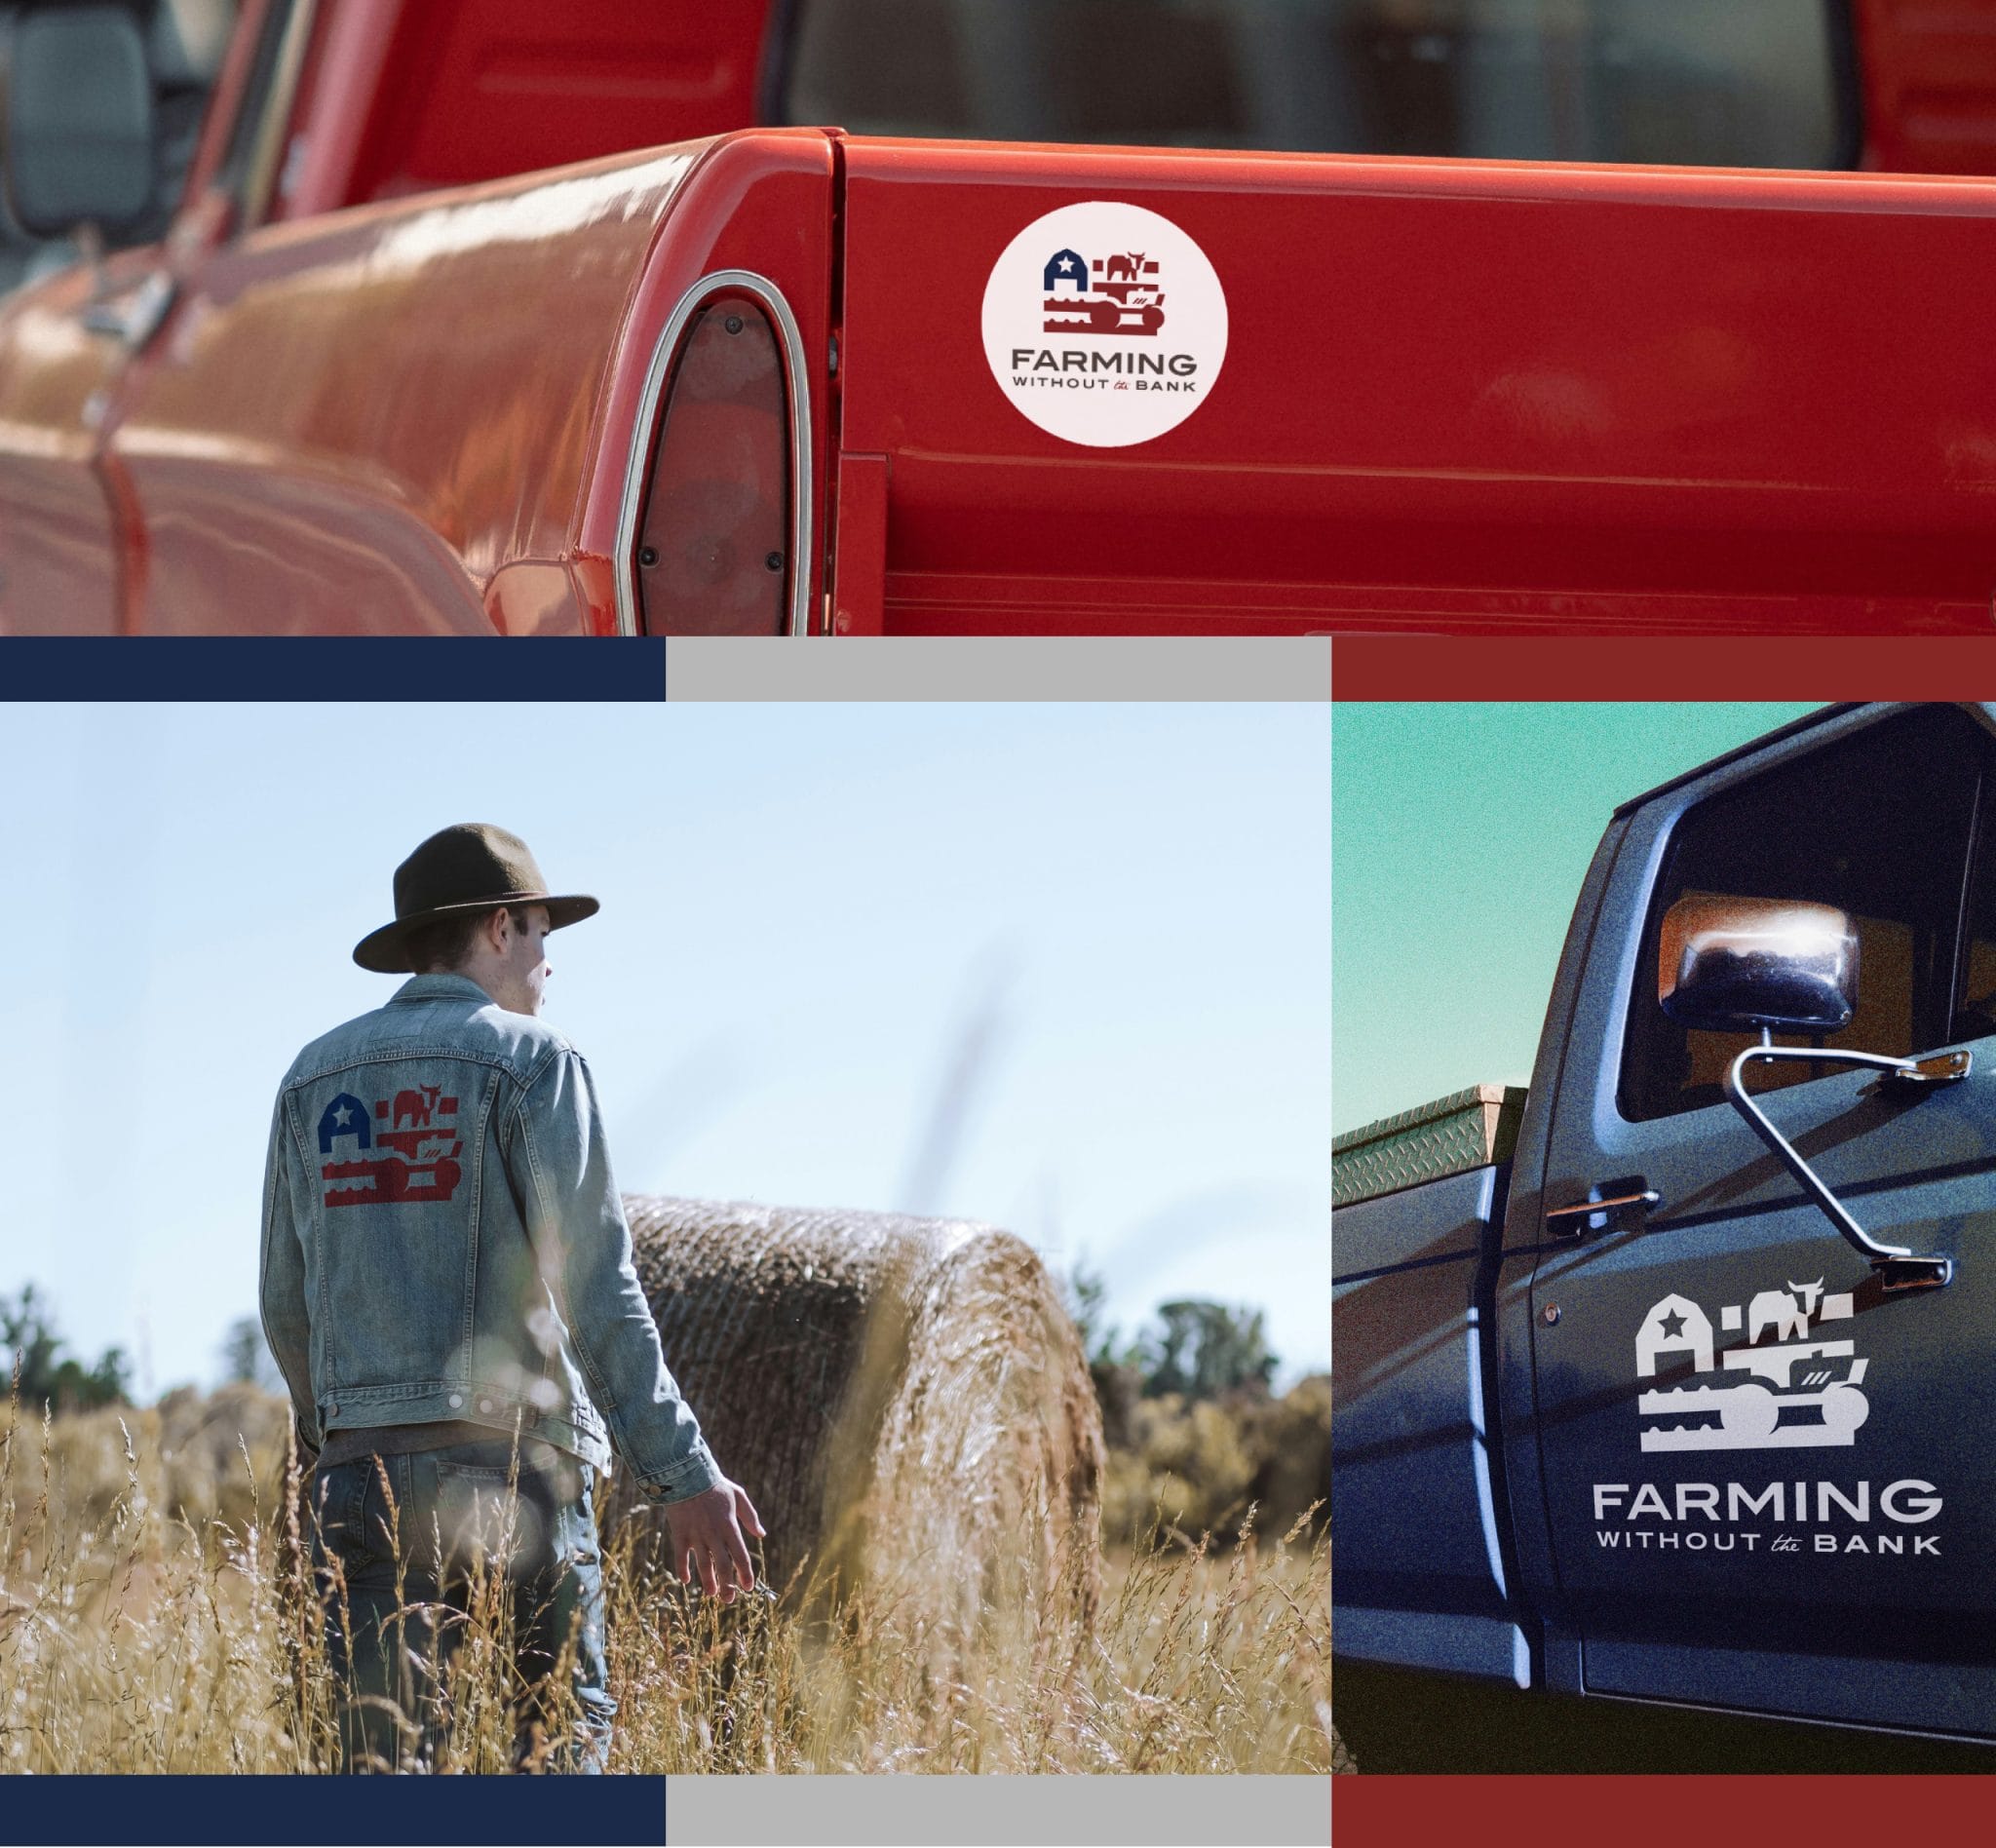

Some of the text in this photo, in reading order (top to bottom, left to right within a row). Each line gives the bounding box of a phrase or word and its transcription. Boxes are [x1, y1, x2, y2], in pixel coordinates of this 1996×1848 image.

[1012, 348, 1198, 376] FARMING
[1013, 376, 1197, 392] WITHOUT the BANK
[1593, 1479, 1943, 1523] FARMING
[1595, 1530, 1942, 1556] WITHOUT the BANK
